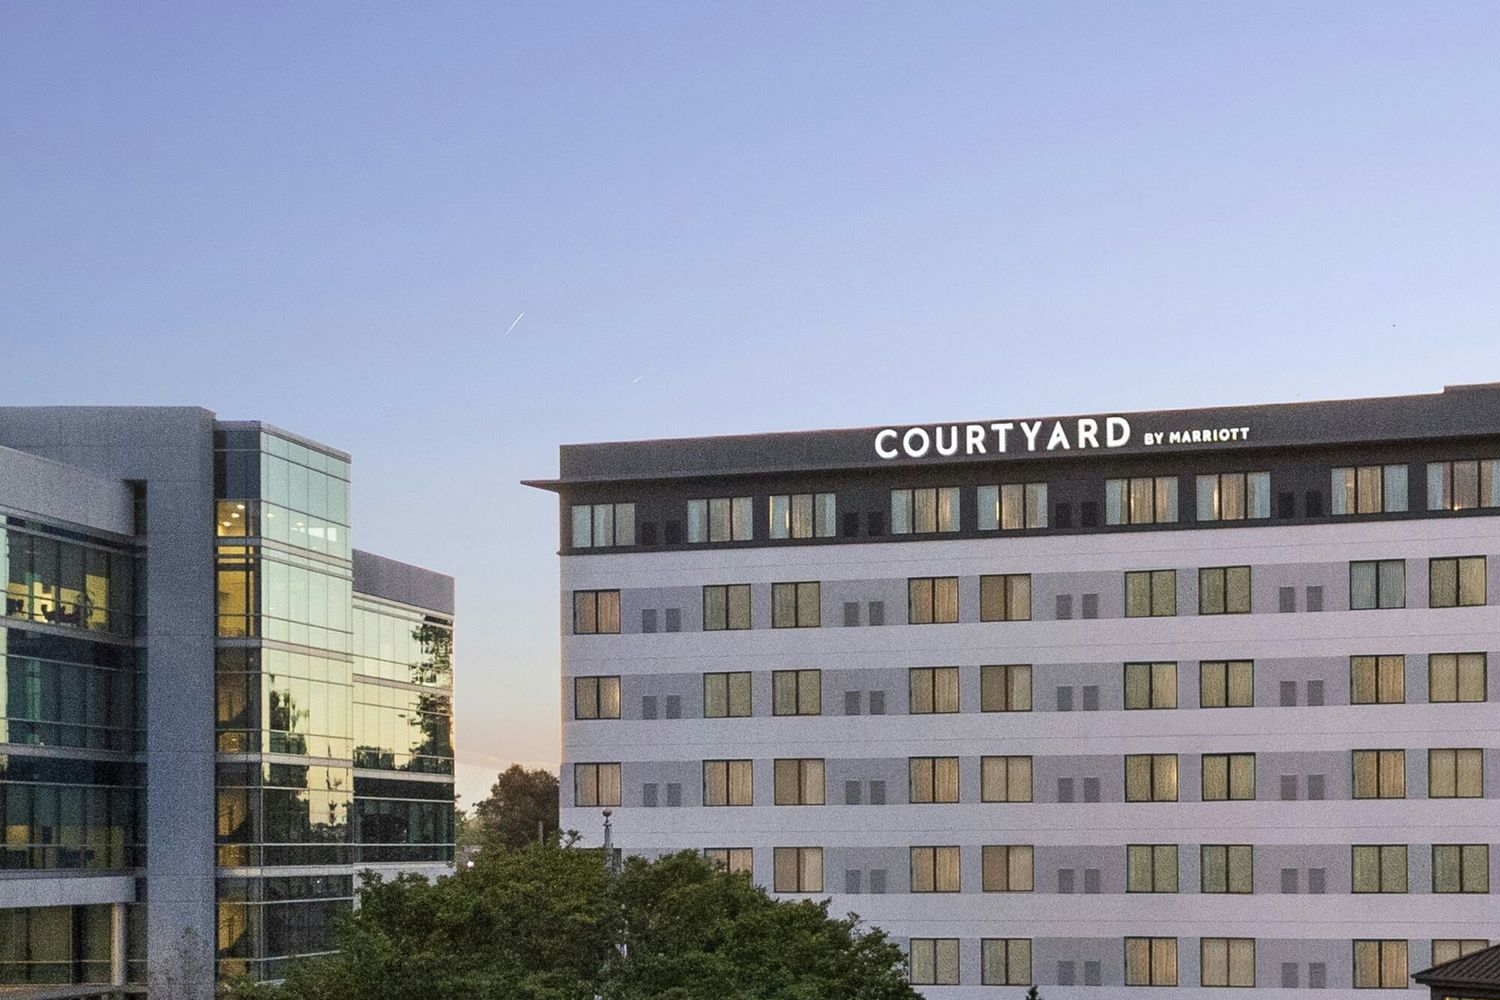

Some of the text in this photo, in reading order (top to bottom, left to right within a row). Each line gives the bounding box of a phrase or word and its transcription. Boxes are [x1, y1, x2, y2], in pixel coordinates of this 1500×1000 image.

[874, 417, 1250, 459] COURTYARD BY MARRIOTT
